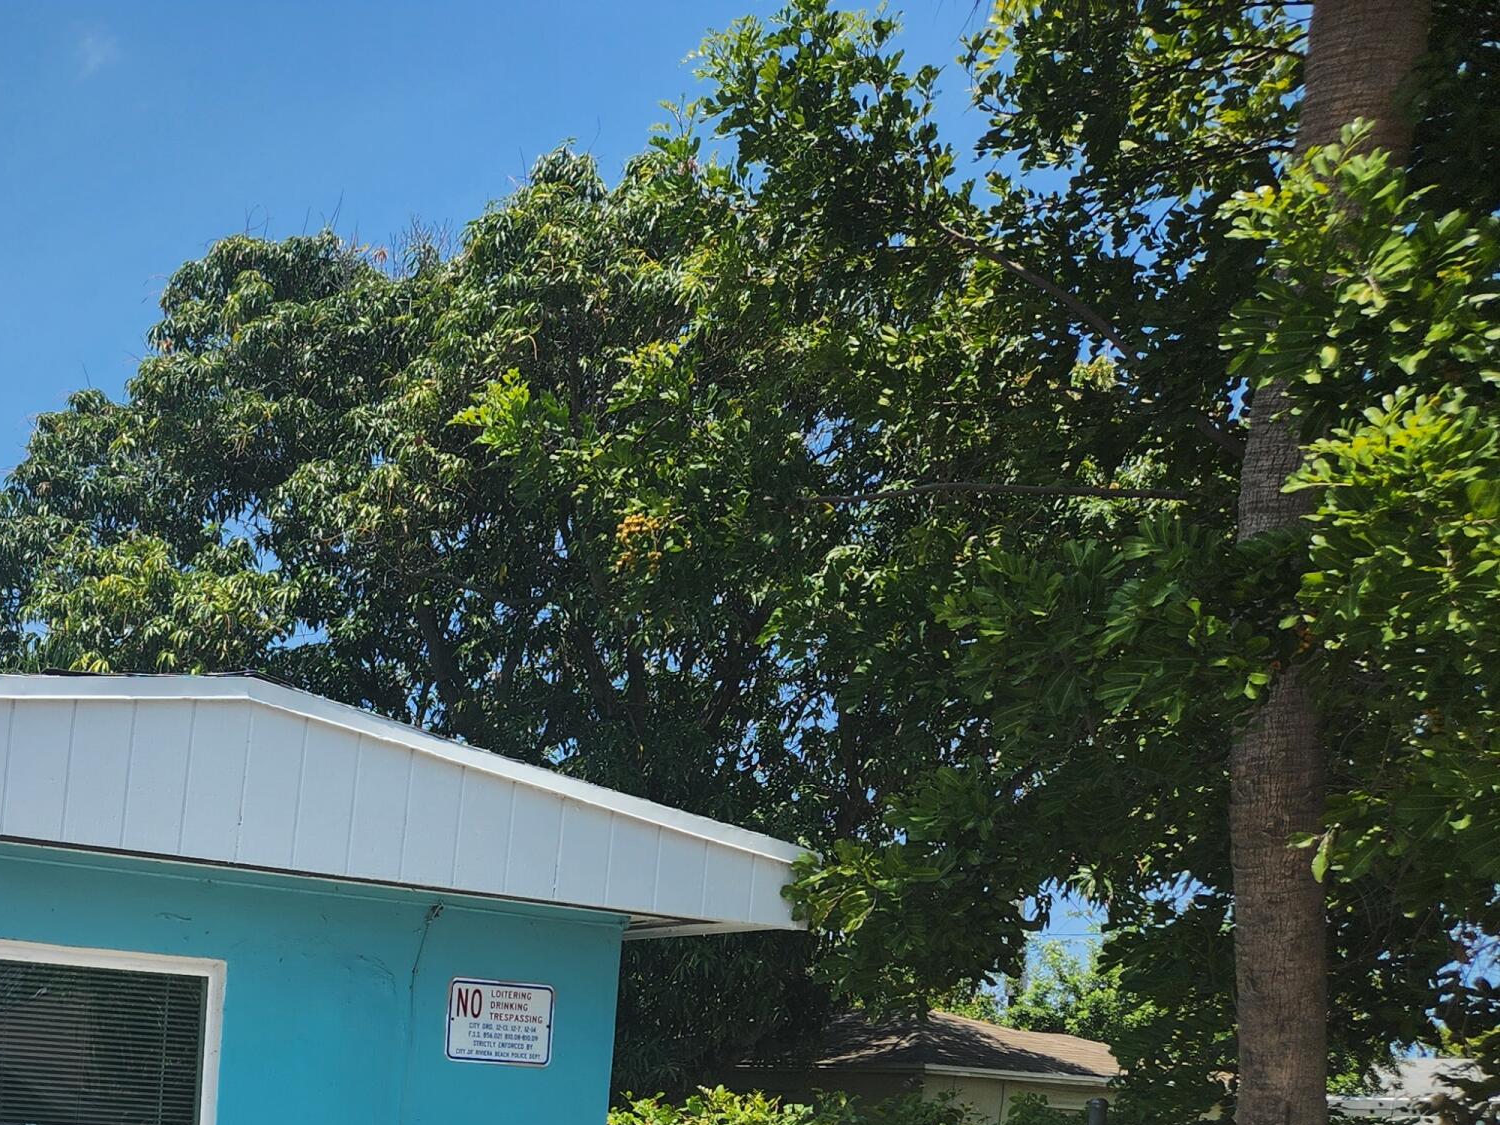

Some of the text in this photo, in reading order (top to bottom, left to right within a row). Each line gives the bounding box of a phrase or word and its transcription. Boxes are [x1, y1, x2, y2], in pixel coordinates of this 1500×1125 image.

[491, 989, 532, 1000] LOITERING
[456, 987, 482, 1018] NO
[490, 1001, 528, 1011] DRINKING
[489, 1012, 543, 1024] TRESPASSING
[473, 1040, 496, 1048] STRICTLY
[498, 1042, 524, 1050] ENFORCED
[475, 1049, 492, 1057] RIVIERA
